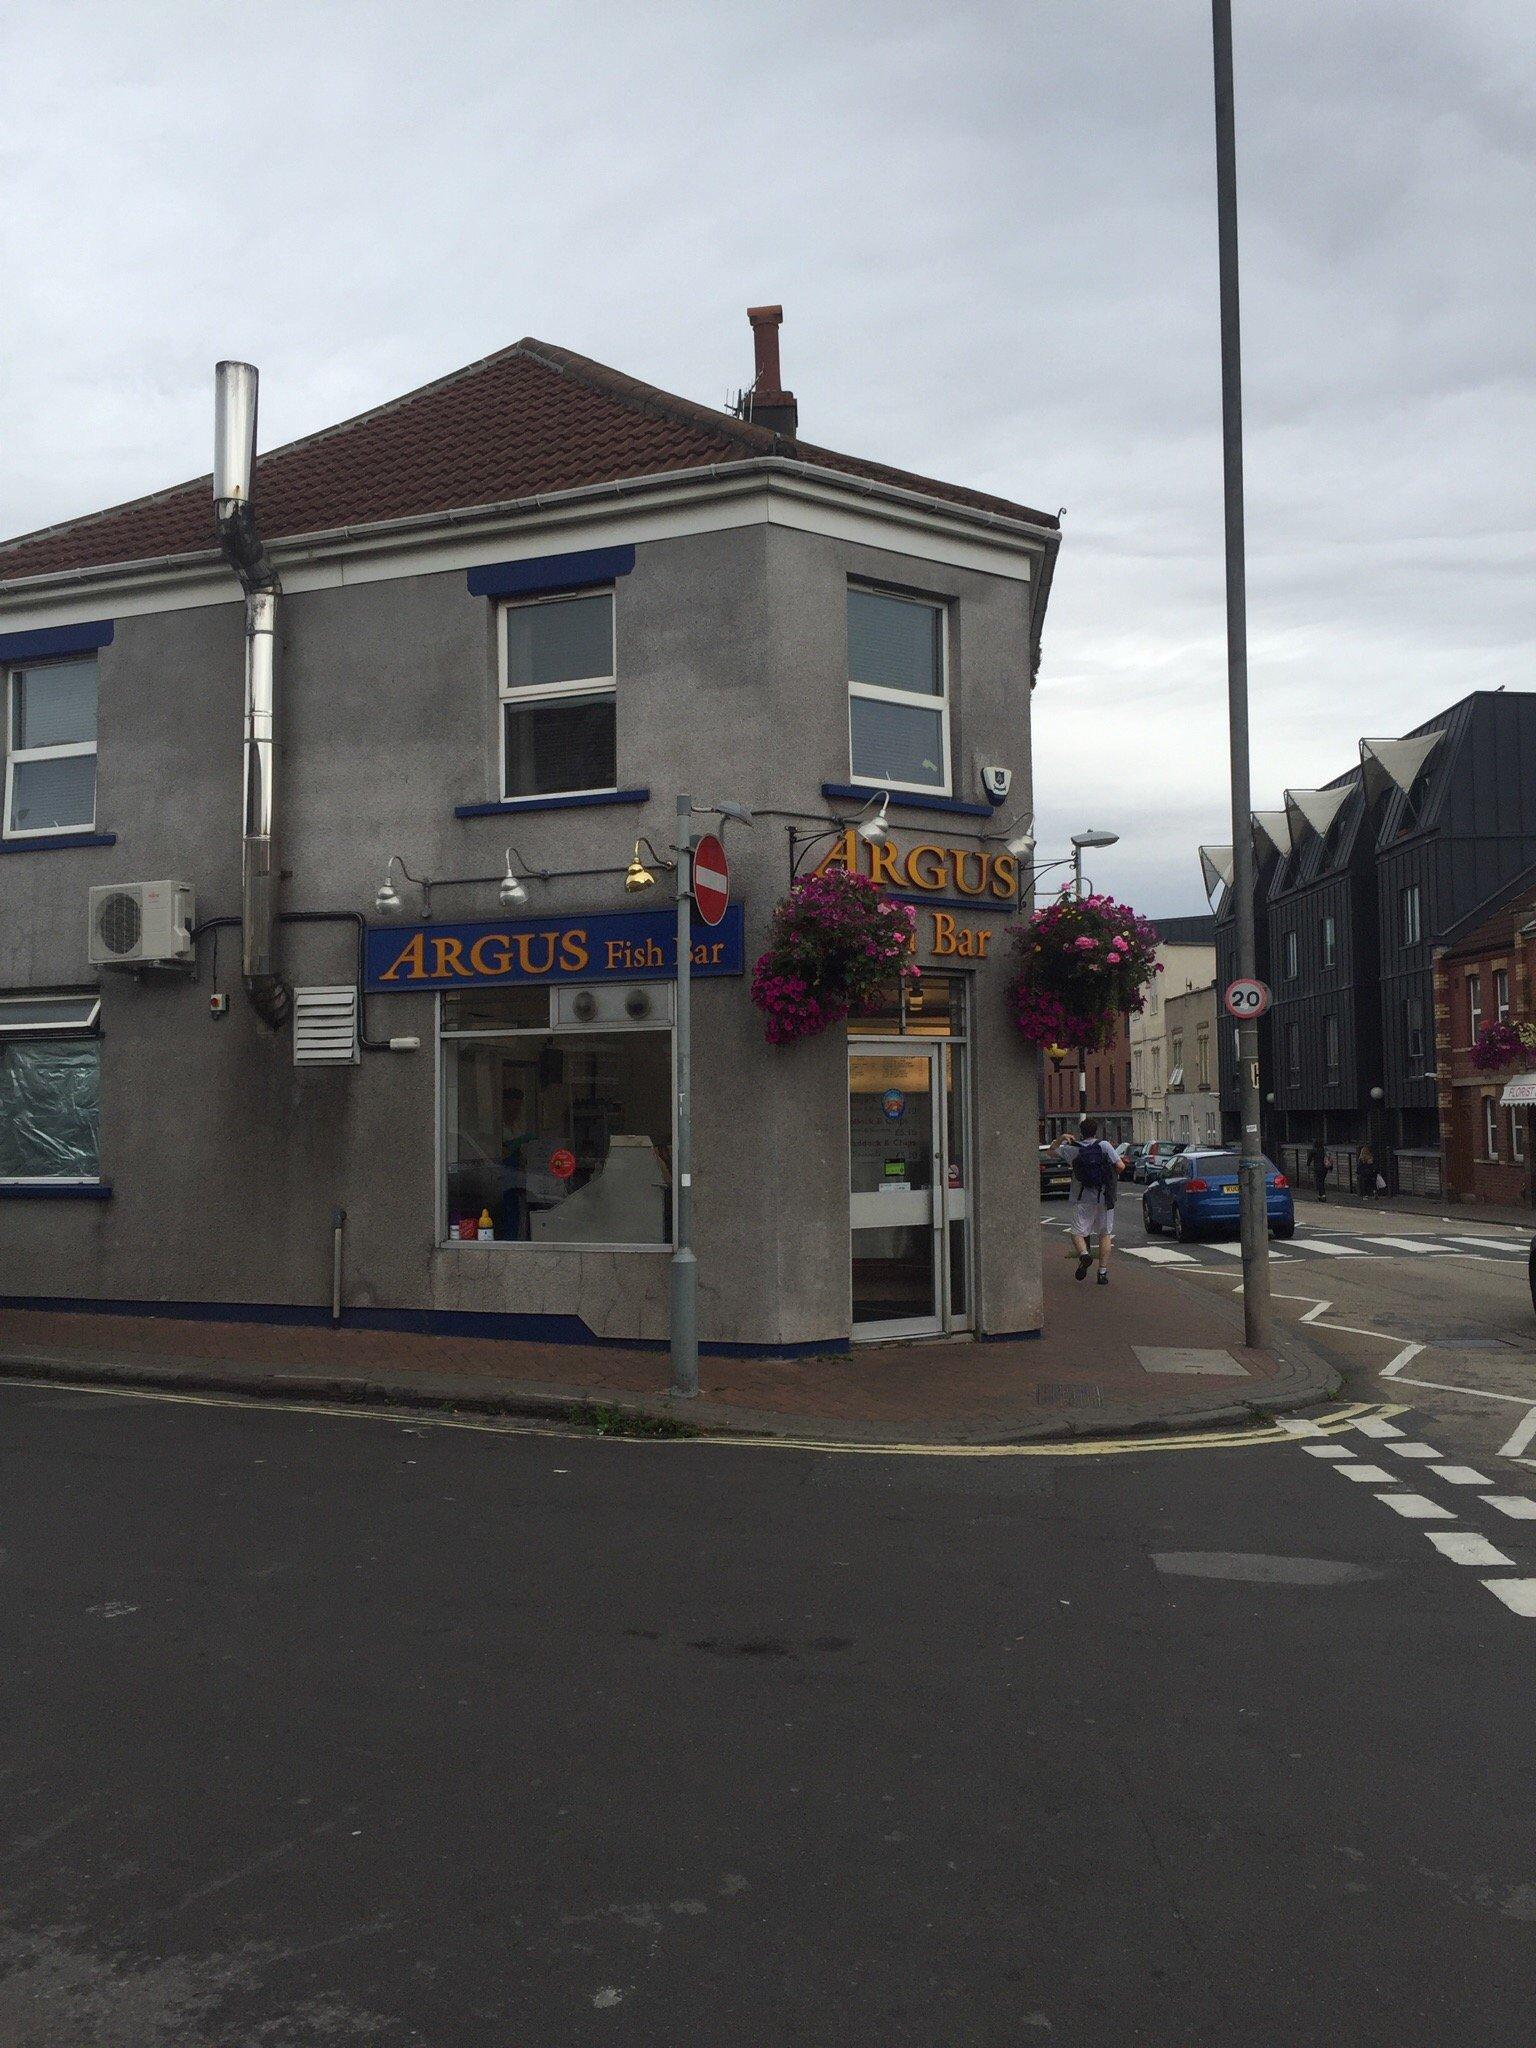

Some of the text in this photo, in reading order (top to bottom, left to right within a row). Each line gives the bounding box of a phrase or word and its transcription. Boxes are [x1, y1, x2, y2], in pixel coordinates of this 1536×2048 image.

[815, 827, 1019, 899] ARGUS
[378, 929, 590, 981] ARGUS
[604, 937, 665, 969] Fish
[931, 911, 992, 958] Bar
[1231, 990, 1260, 1007] 20
[1508, 1086, 1535, 1098] FLORIST
